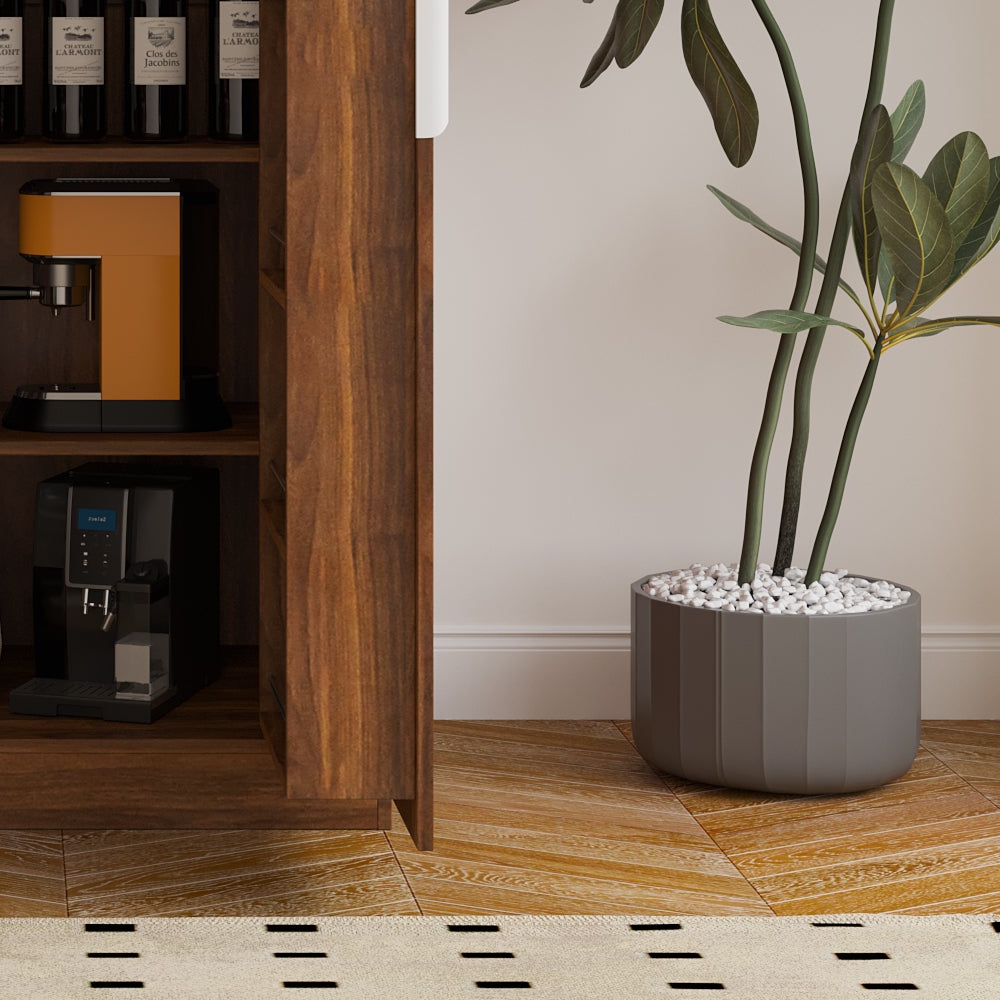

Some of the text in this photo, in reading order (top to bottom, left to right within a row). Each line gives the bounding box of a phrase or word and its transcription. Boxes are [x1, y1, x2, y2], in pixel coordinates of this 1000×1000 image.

[223, 37, 259, 45] L'ARMO
[146, 50, 178, 58] Clos des
[143, 58, 180, 68] Jacobins
